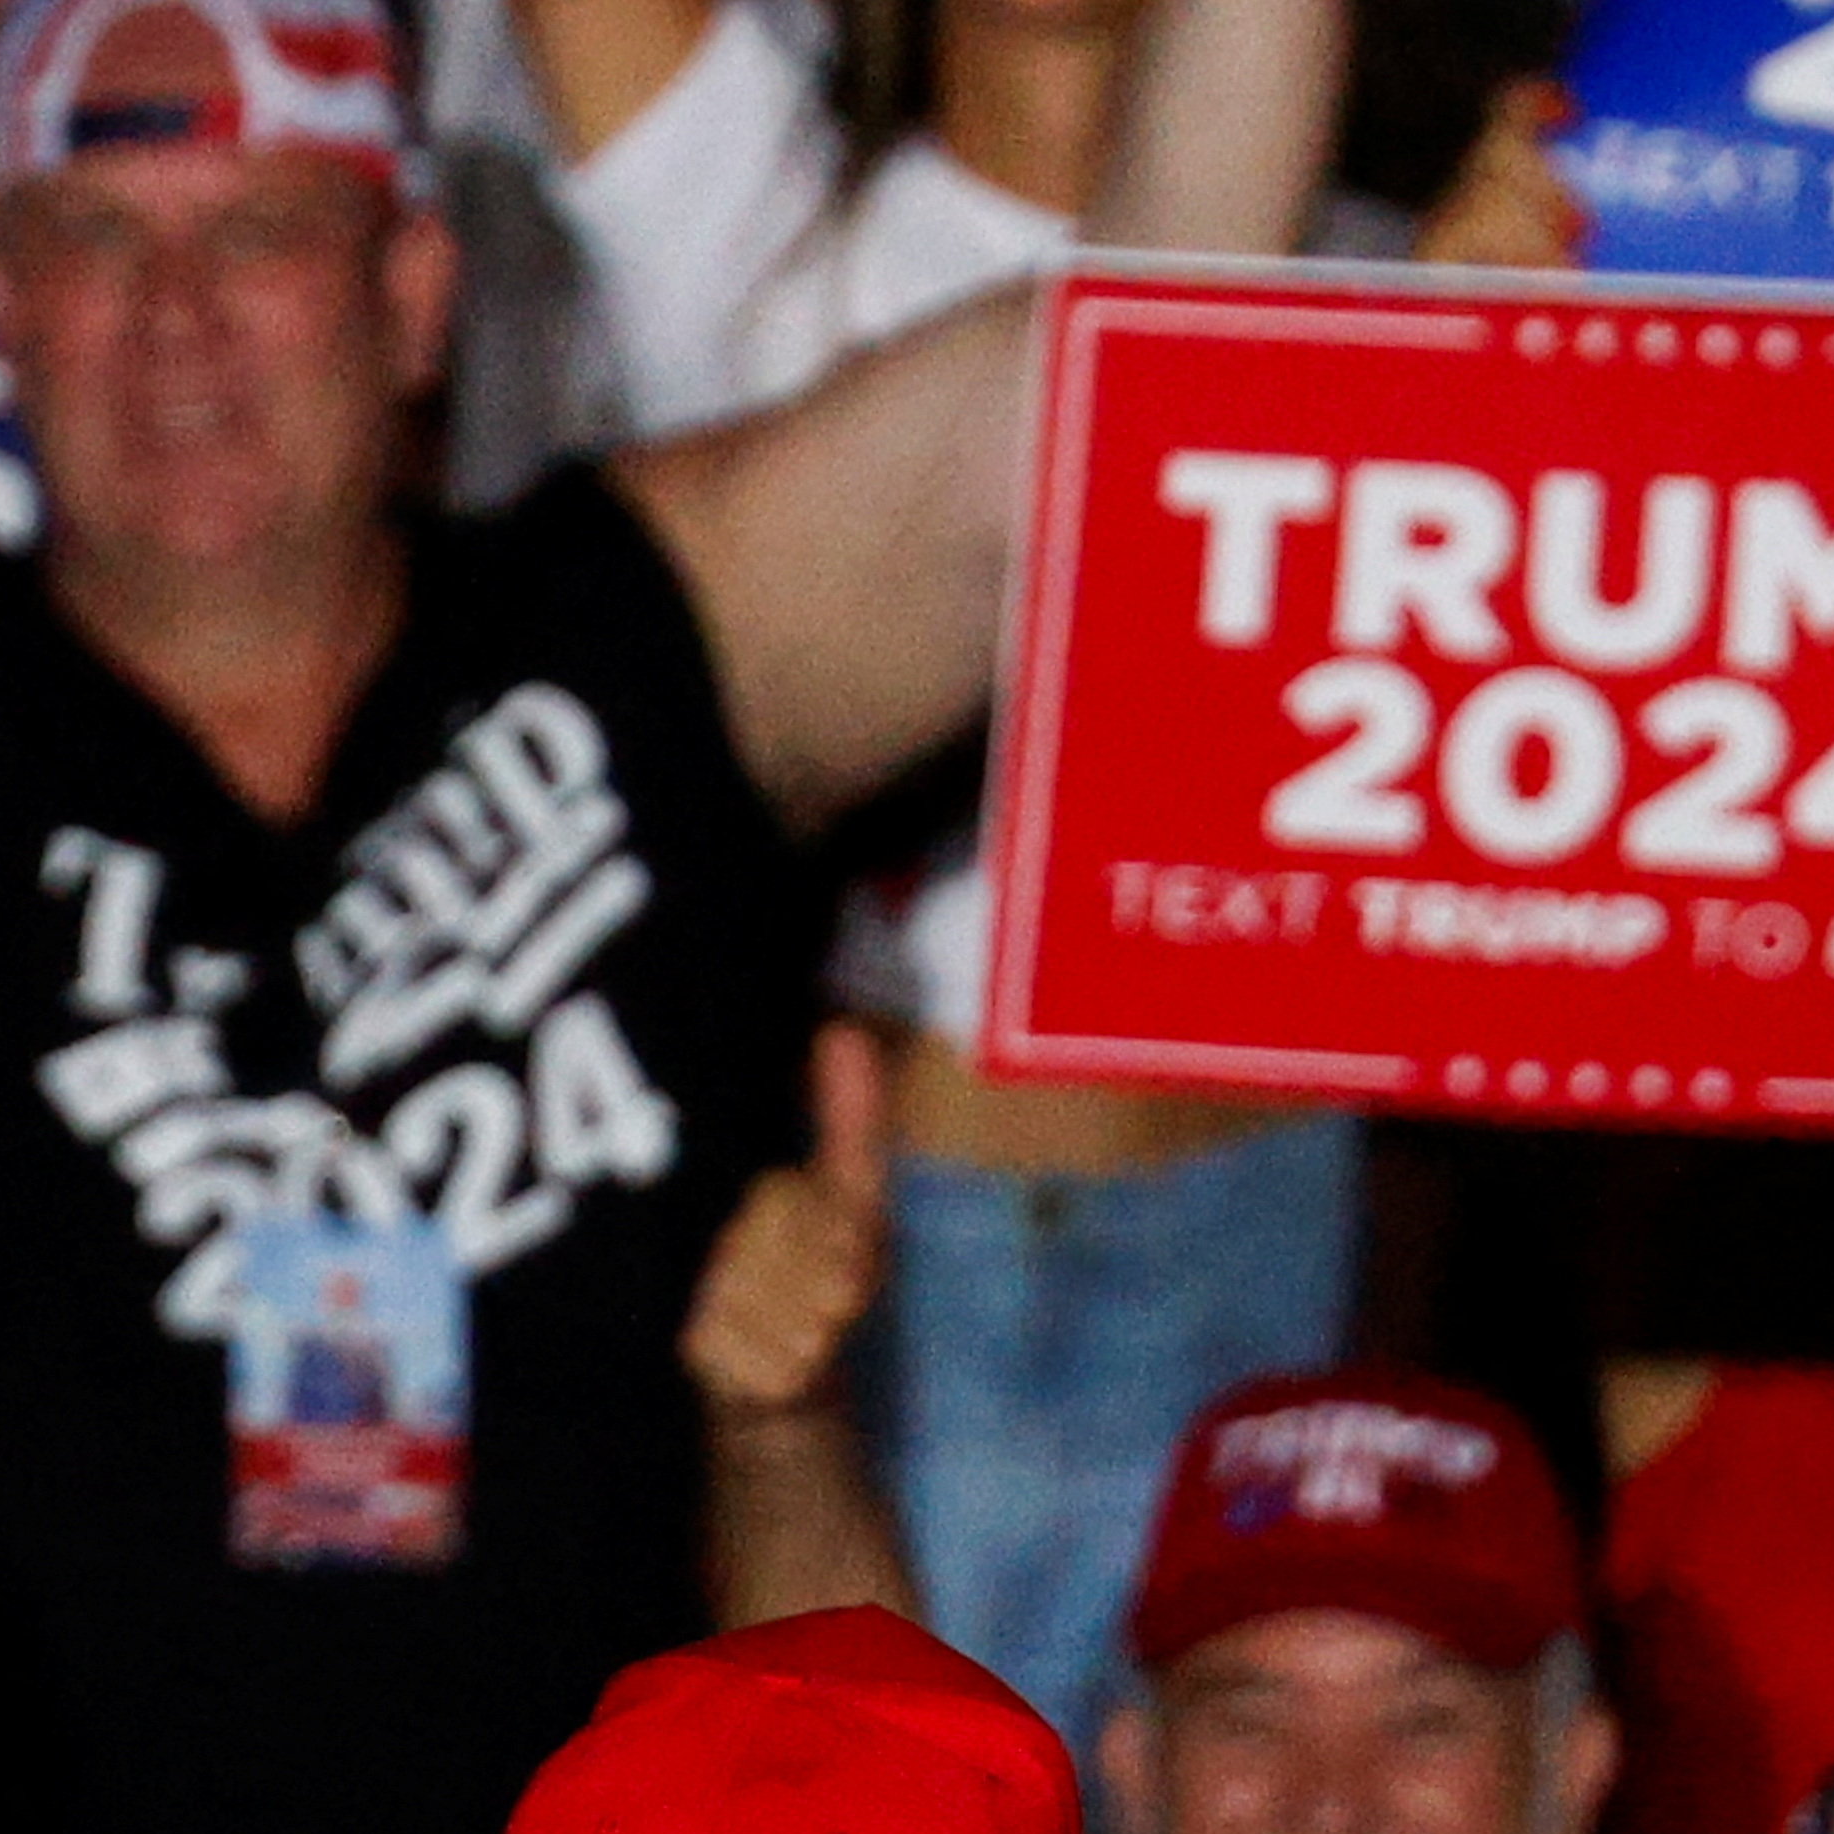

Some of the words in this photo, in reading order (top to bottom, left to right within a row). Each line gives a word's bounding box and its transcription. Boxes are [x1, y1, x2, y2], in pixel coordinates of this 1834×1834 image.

[1105, 858, 1332, 946] TEXT
[1348, 874, 1671, 967] TRUMP
[1687, 895, 1812, 981] TO
